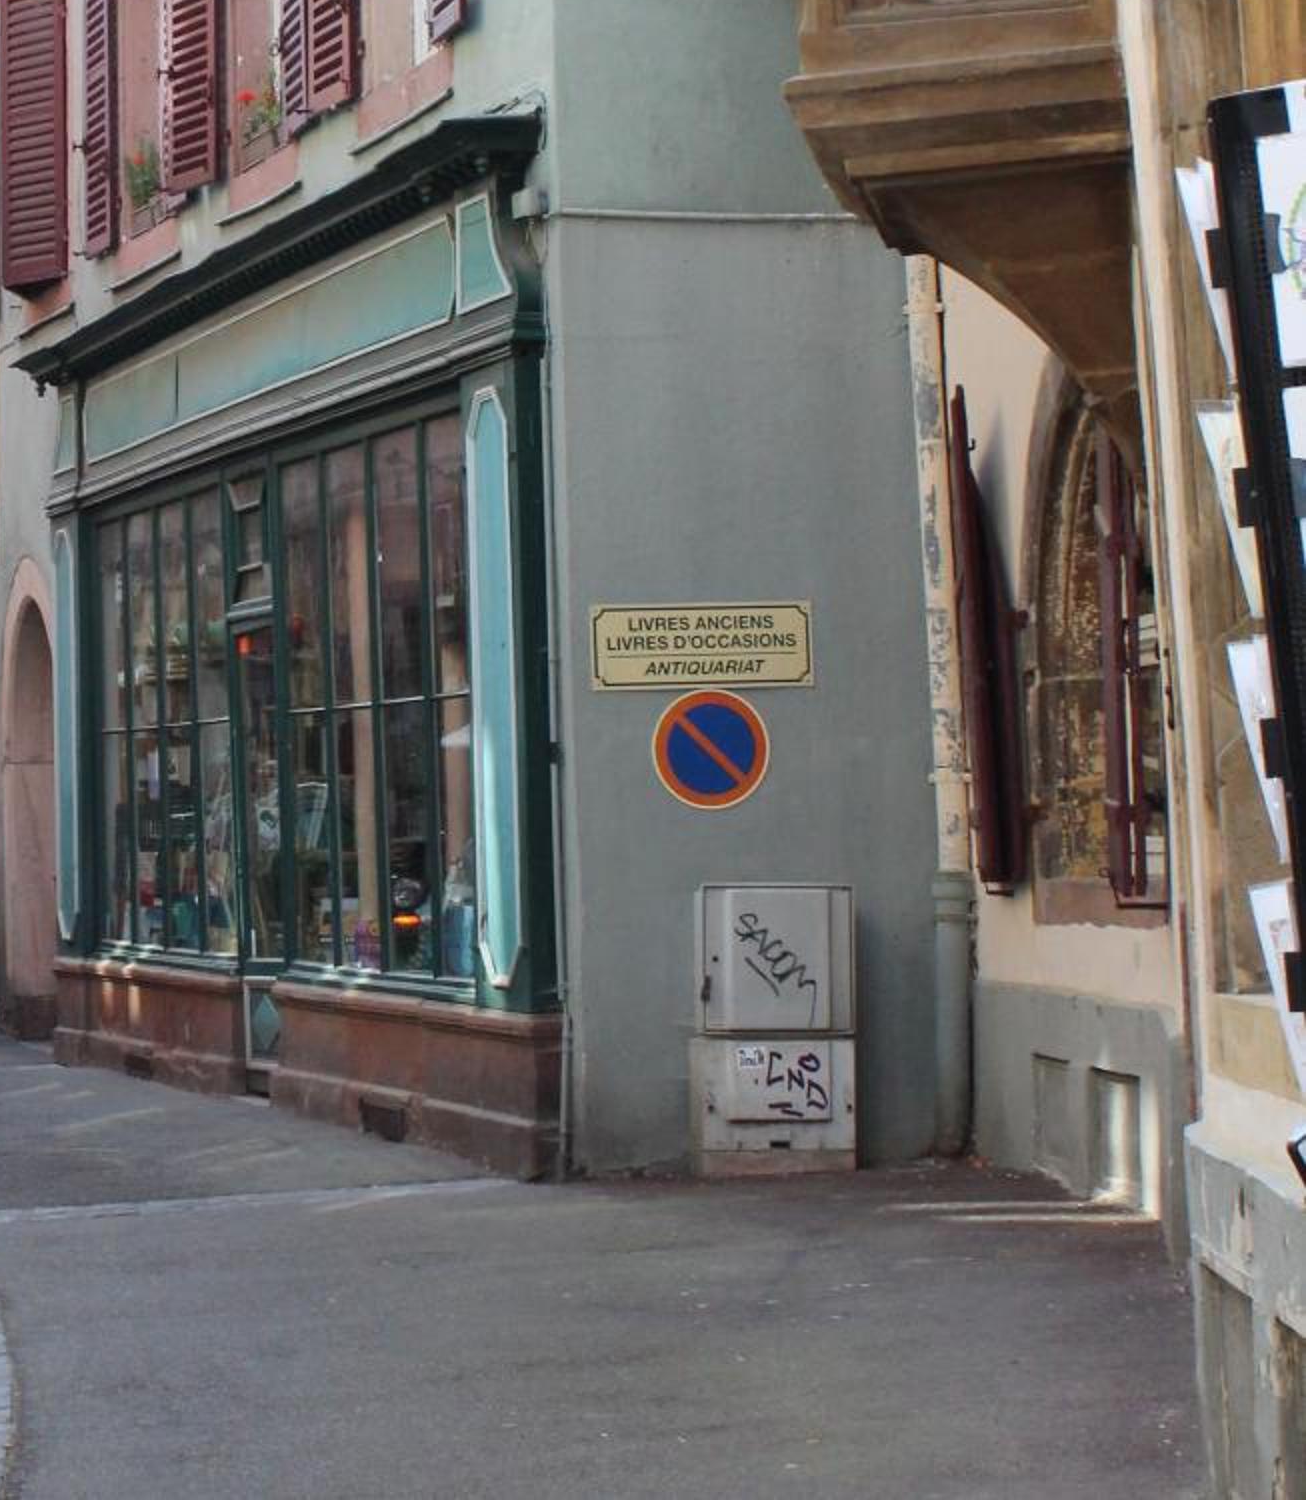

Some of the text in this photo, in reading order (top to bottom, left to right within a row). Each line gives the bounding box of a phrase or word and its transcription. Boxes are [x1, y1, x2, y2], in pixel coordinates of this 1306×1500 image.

[628, 615, 774, 632] LIVRES ANCIENS
[606, 633, 796, 650] LIVRES D'OCCASIONS
[645, 659, 765, 676] ANTIQUARIAT
